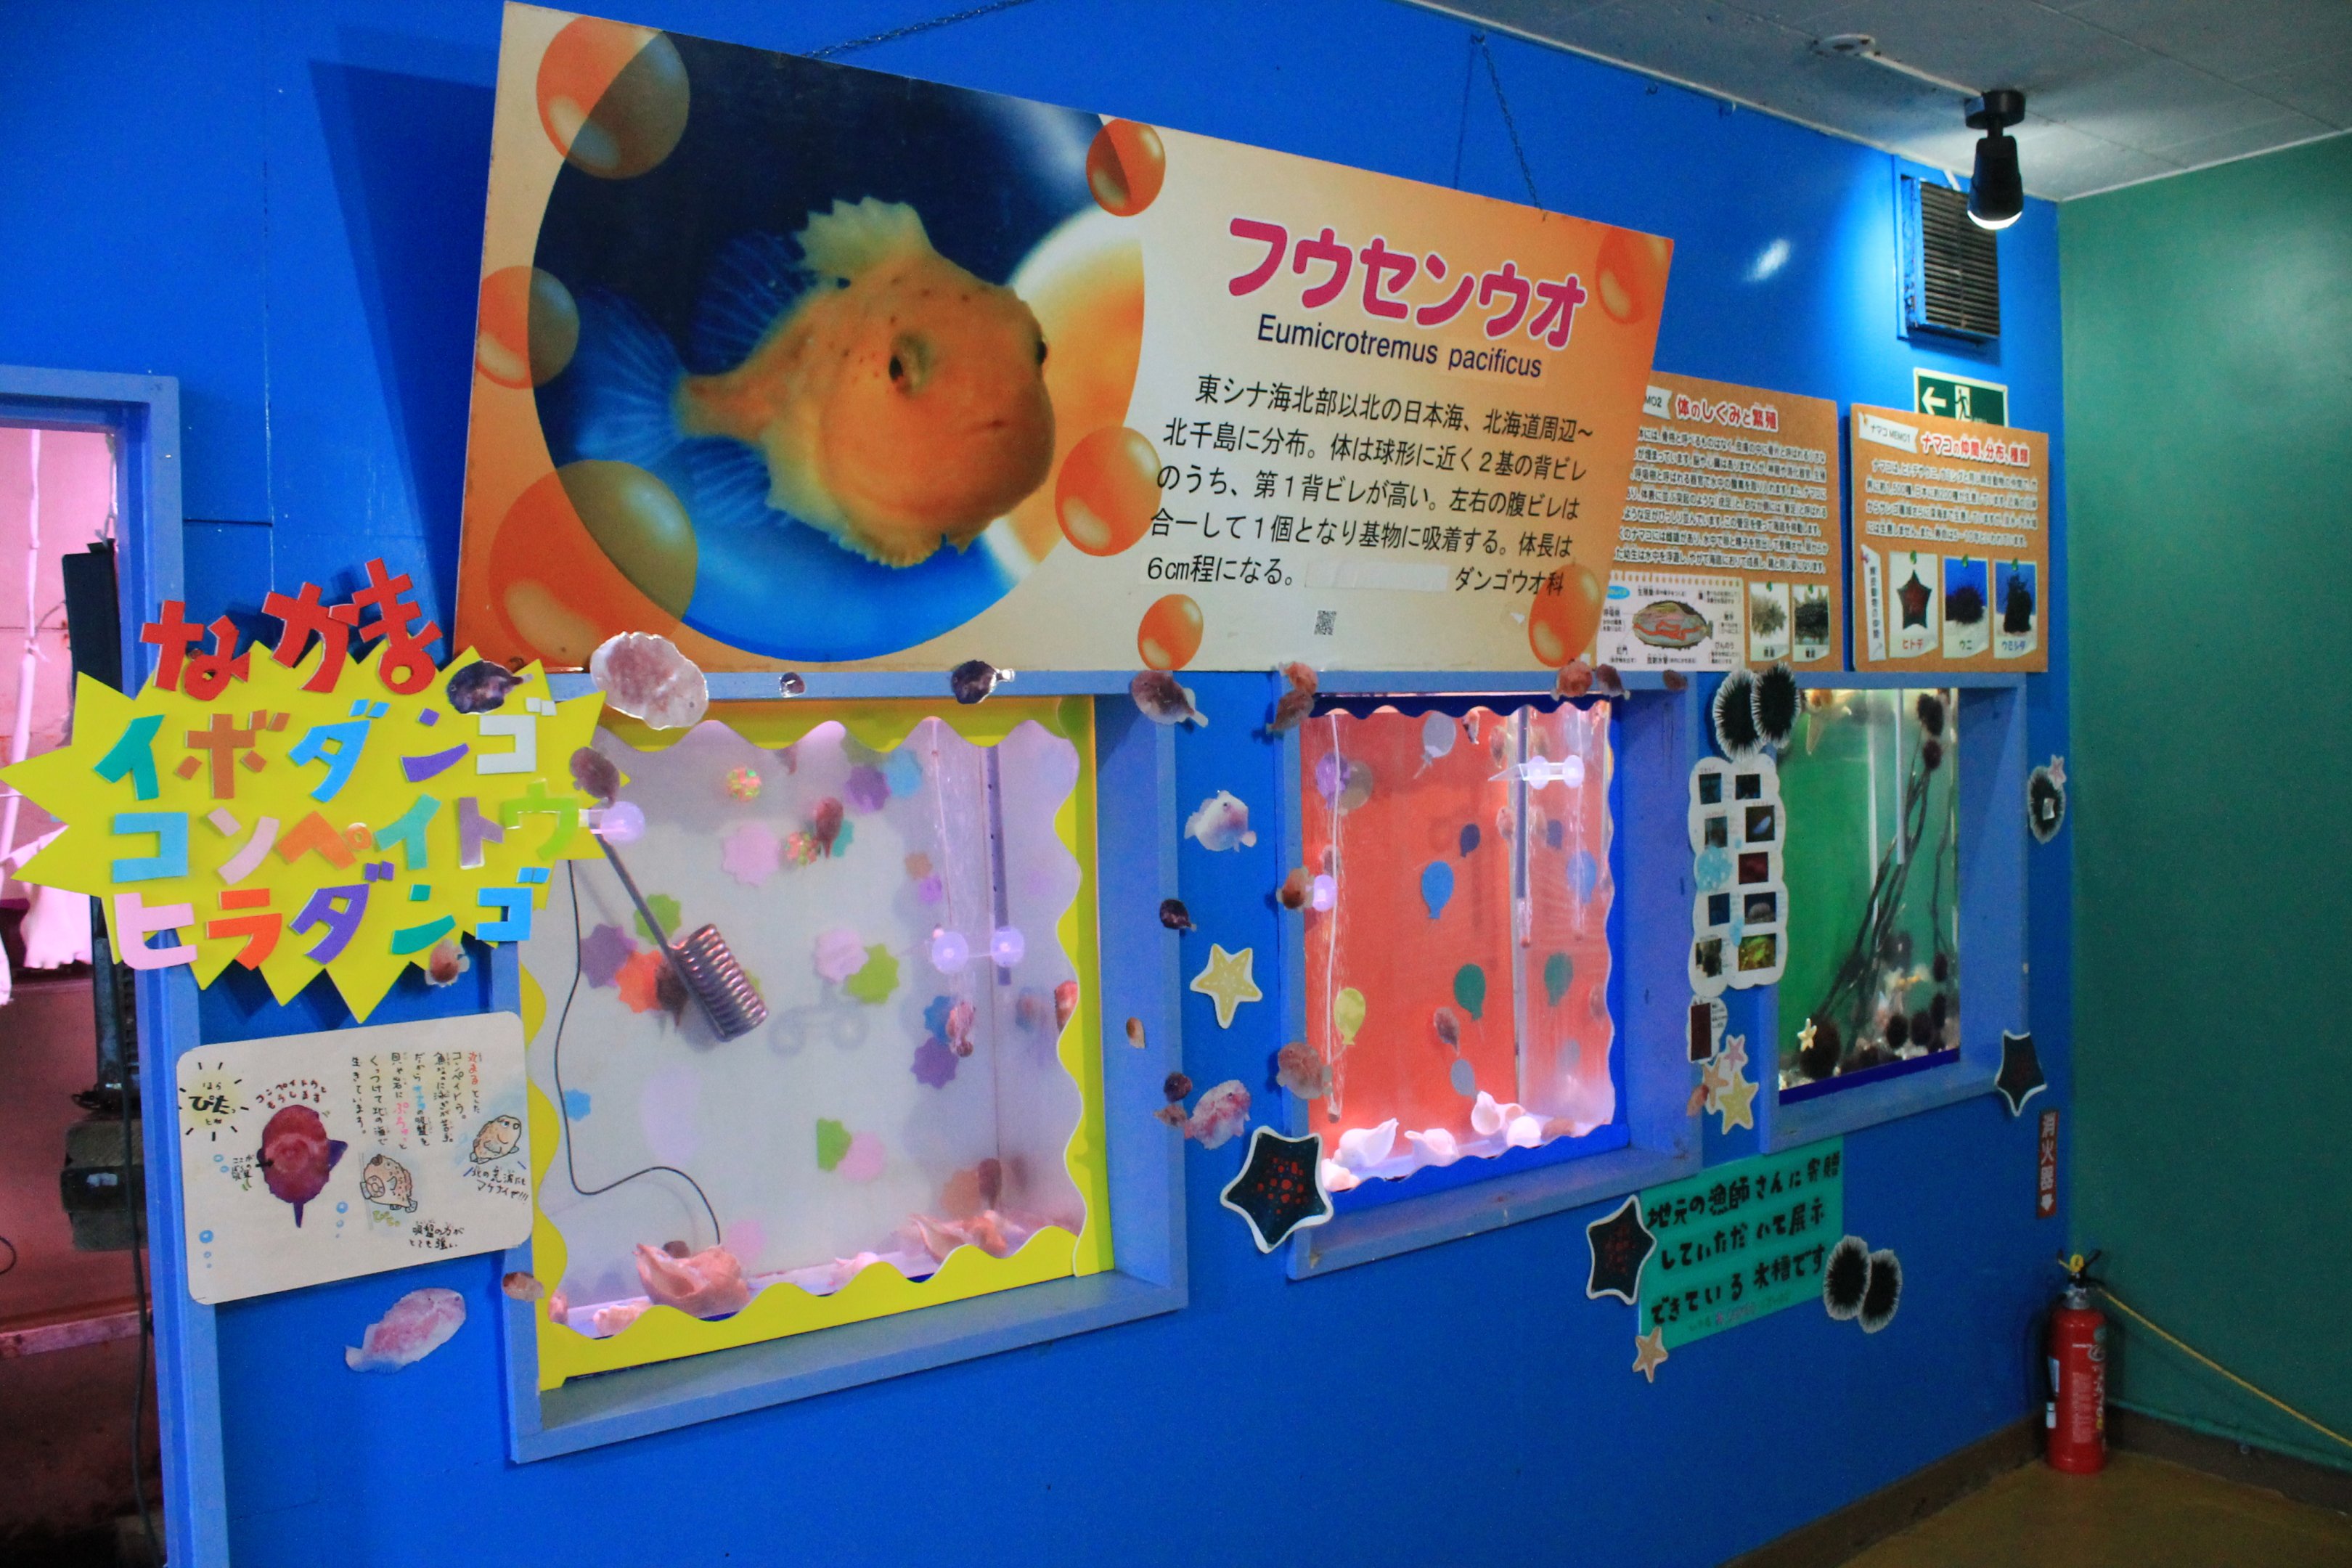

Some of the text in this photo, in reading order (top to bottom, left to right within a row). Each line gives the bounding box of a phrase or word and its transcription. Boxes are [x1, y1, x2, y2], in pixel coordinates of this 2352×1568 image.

[1228, 217, 1587, 349] フウセンウオ
[1258, 312, 1542, 379] Eumicrotremus pacificus
[1196, 374, 1594, 441] 東シナ海北部以北の日本海、北海道周辺~
[1678, 398, 1778, 430] 体のしくみと繁殖
[1871, 425, 1911, 443] ナマコ MEMO1
[1162, 417, 1588, 483] 北千島に分布。体は球形に近く2基の背ビレ
[1922, 435, 2030, 465] ナマコの仲間、分布、種類
[1157, 462, 1580, 522] のうち、第1背ビレが高い。左右の腹ビレは
[1151, 506, 1572, 558] 合一して1個となり基物に吸着する。体長は
[1455, 568, 1564, 596] ダンゴウオ科
[140, 558, 442, 701] なかま
[1903, 639, 1924, 650] ヒトデ
[1959, 640, 1972, 650] ウニ
[94, 697, 557, 803] イボダンゴ
[111, 780, 581, 885] コンペイトウ
[113, 860, 551, 971] ヒラダンゴ
[256, 1079, 327, 1103] コンペイトウと
[351, 1056, 367, 1135] 生きています。
[452, 1051, 467, 1119] コンペイトウ。
[2041, 1114, 2056, 1191] 消火器
[1646, 1151, 1841, 1229] 地元の漁師さんに寄贈
[1661, 1198, 1825, 1270] していただいて展示
[1651, 1244, 1826, 1325] できている水槽です
